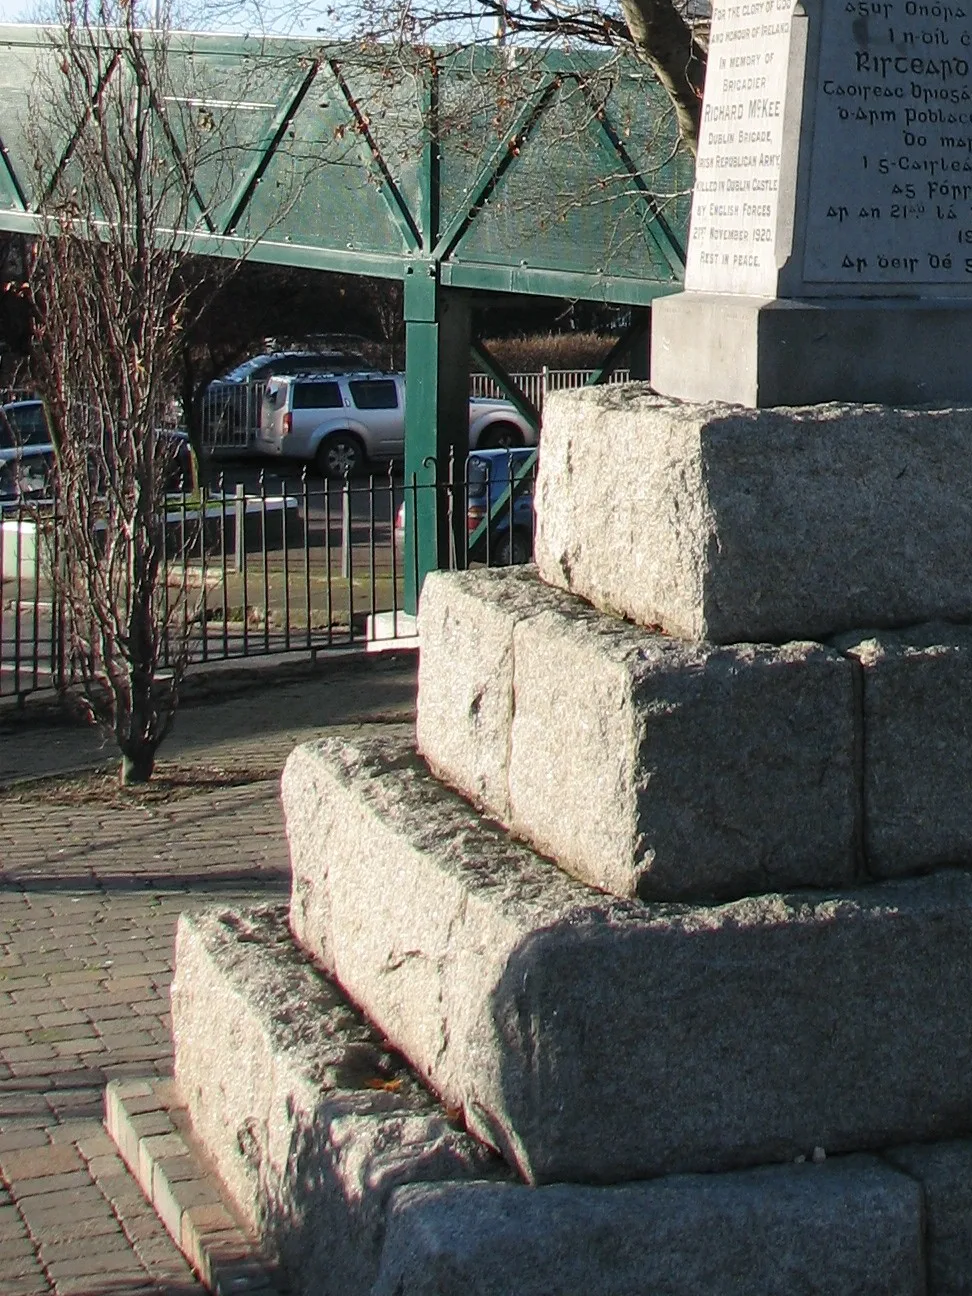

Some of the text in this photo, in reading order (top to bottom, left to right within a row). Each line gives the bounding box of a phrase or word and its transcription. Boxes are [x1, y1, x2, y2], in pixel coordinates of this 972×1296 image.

[729, 53, 761, 69] MEMORY
[764, 52, 774, 65] OF
[723, 76, 767, 92] BRIGADIER
[704, 103, 744, 123] RICHARD
[708, 131, 735, 145] DUBLIN
[903, 129, 928, 146] Do
[715, 154, 757, 168] REPUBLICAN
[752, 177, 778, 192] CASTLE
[891, 183, 917, 199] ag
[709, 203, 739, 216] ENGLISH
[742, 202, 771, 217] FORCES
[826, 205, 849, 223] Ar
[858, 206, 881, 219] an
[709, 226, 749, 242] NOVEMBER
[700, 250, 719, 264] REST
[721, 254, 730, 265] IN
[841, 253, 868, 274] Ar
[927, 252, 953, 269] Dé
